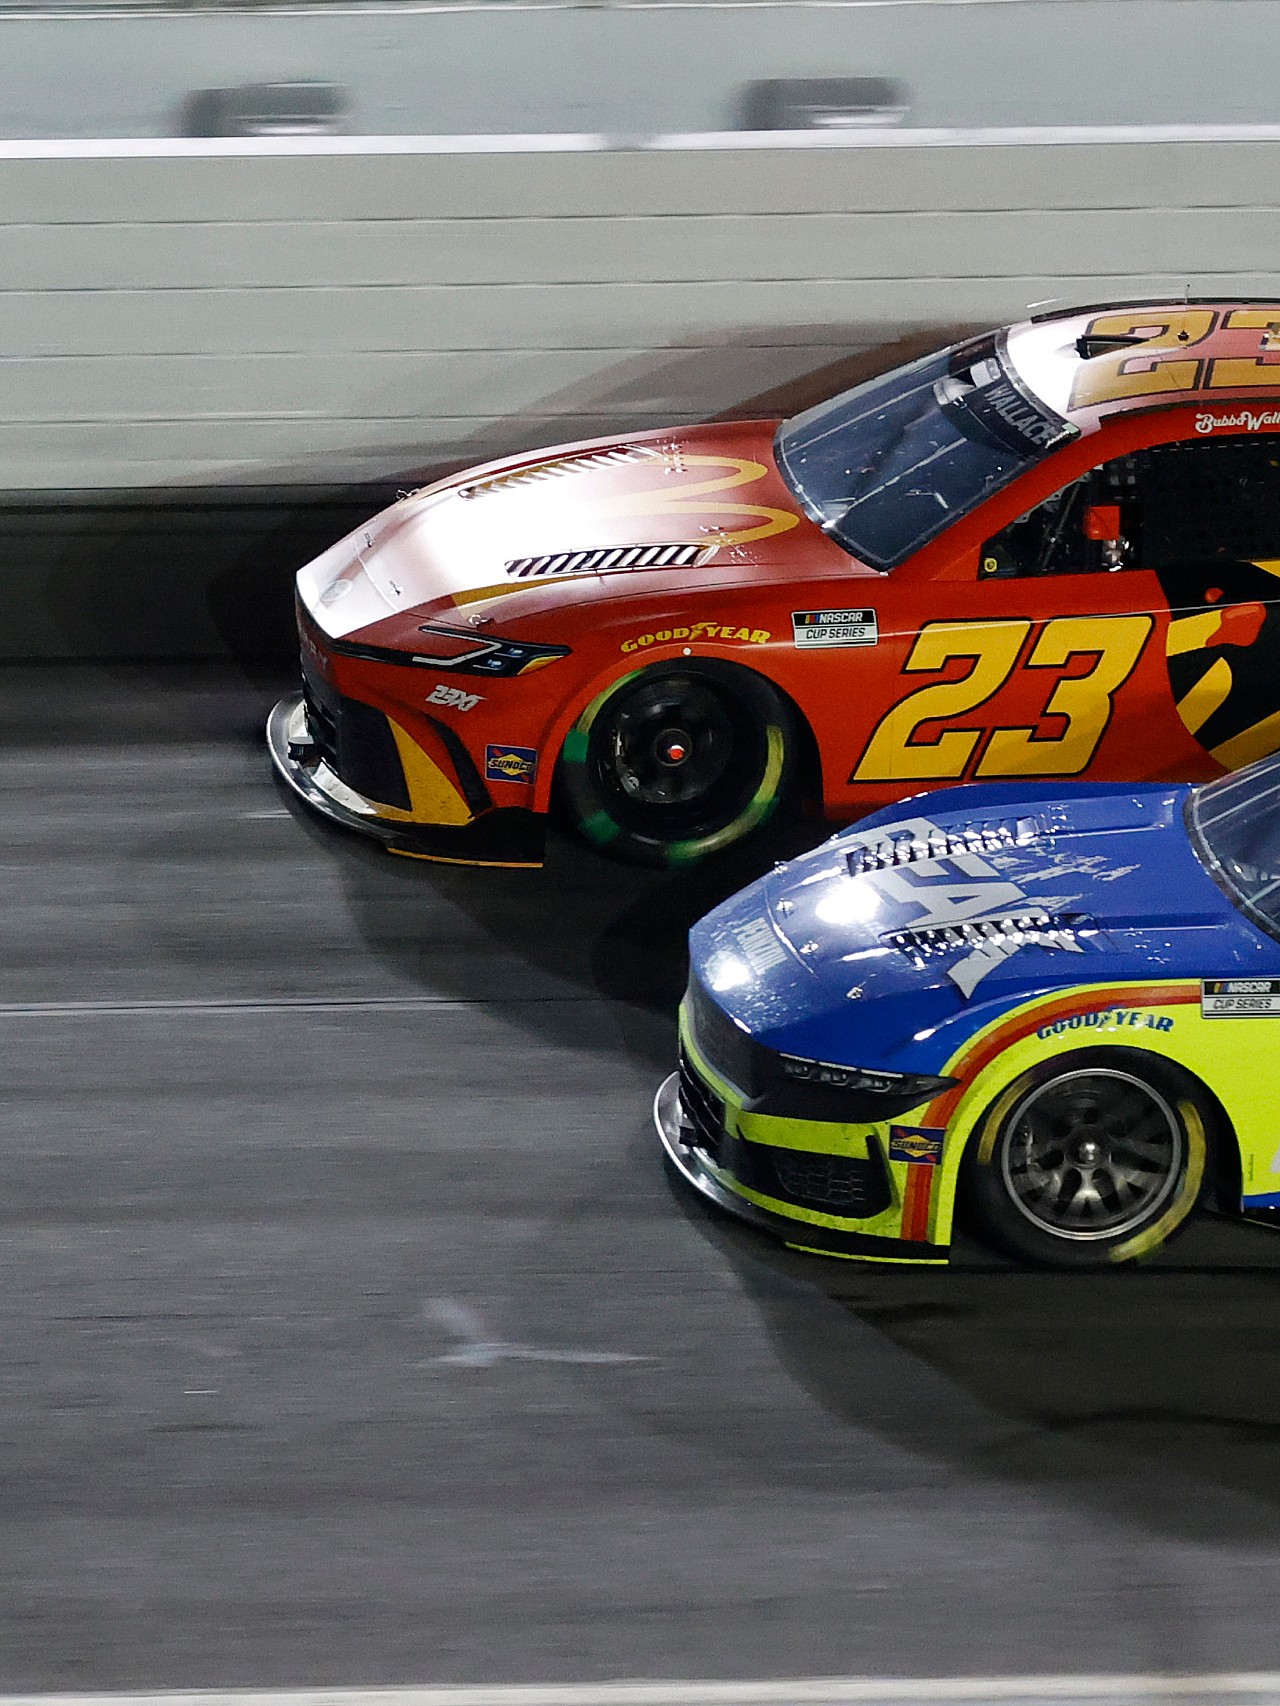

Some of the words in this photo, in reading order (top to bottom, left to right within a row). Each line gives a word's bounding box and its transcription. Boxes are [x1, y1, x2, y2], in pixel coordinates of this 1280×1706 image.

[984, 383, 1061, 445] WALLACE
[819, 612, 863, 624] NASCAR
[621, 622, 771, 653] GOODYEAR
[806, 629, 827, 640] CUP
[829, 627, 866, 638] SERIES
[847, 613, 1155, 783] 23
[489, 758, 533, 772] SUNOCO
[1228, 982, 1272, 993] NASCAR
[1213, 999, 1235, 1009] CUP
[1236, 998, 1273, 1009] SERIES
[1037, 1006, 1174, 1040] GOODYEAR
[891, 1139, 942, 1153] SUNOCO
